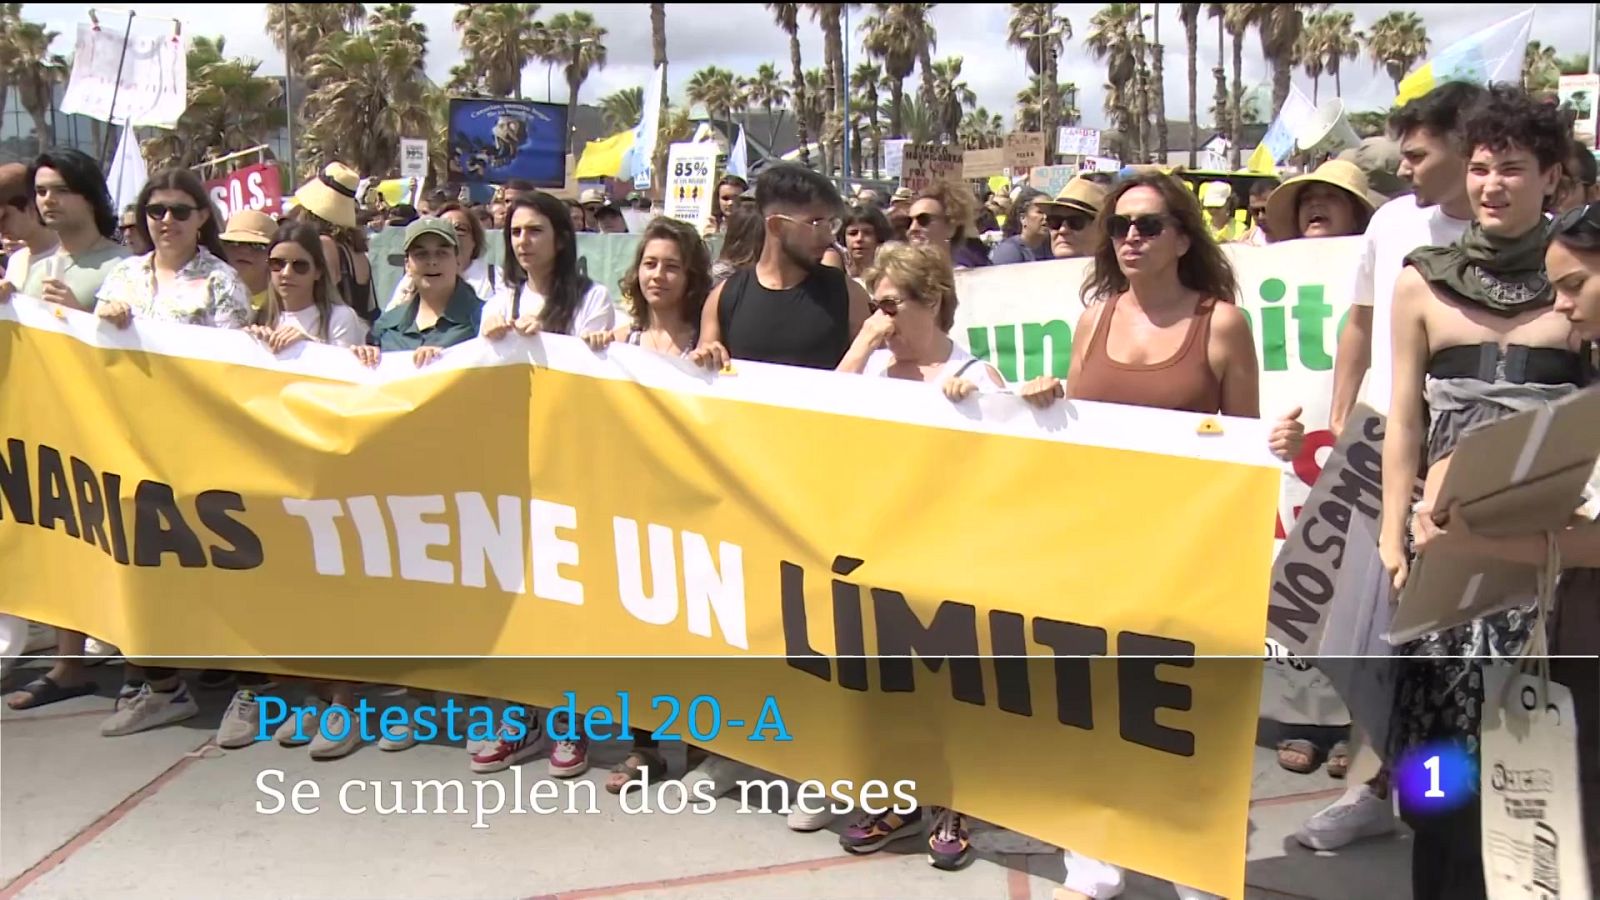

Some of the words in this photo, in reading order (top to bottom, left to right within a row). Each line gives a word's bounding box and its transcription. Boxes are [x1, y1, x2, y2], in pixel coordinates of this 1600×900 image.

[674, 162, 708, 177] 85%
[282, 491, 585, 606] TIENE
[612, 515, 749, 650] UN
[780, 554, 1196, 757] LÍMITE
[1267, 561, 1334, 644] NO
